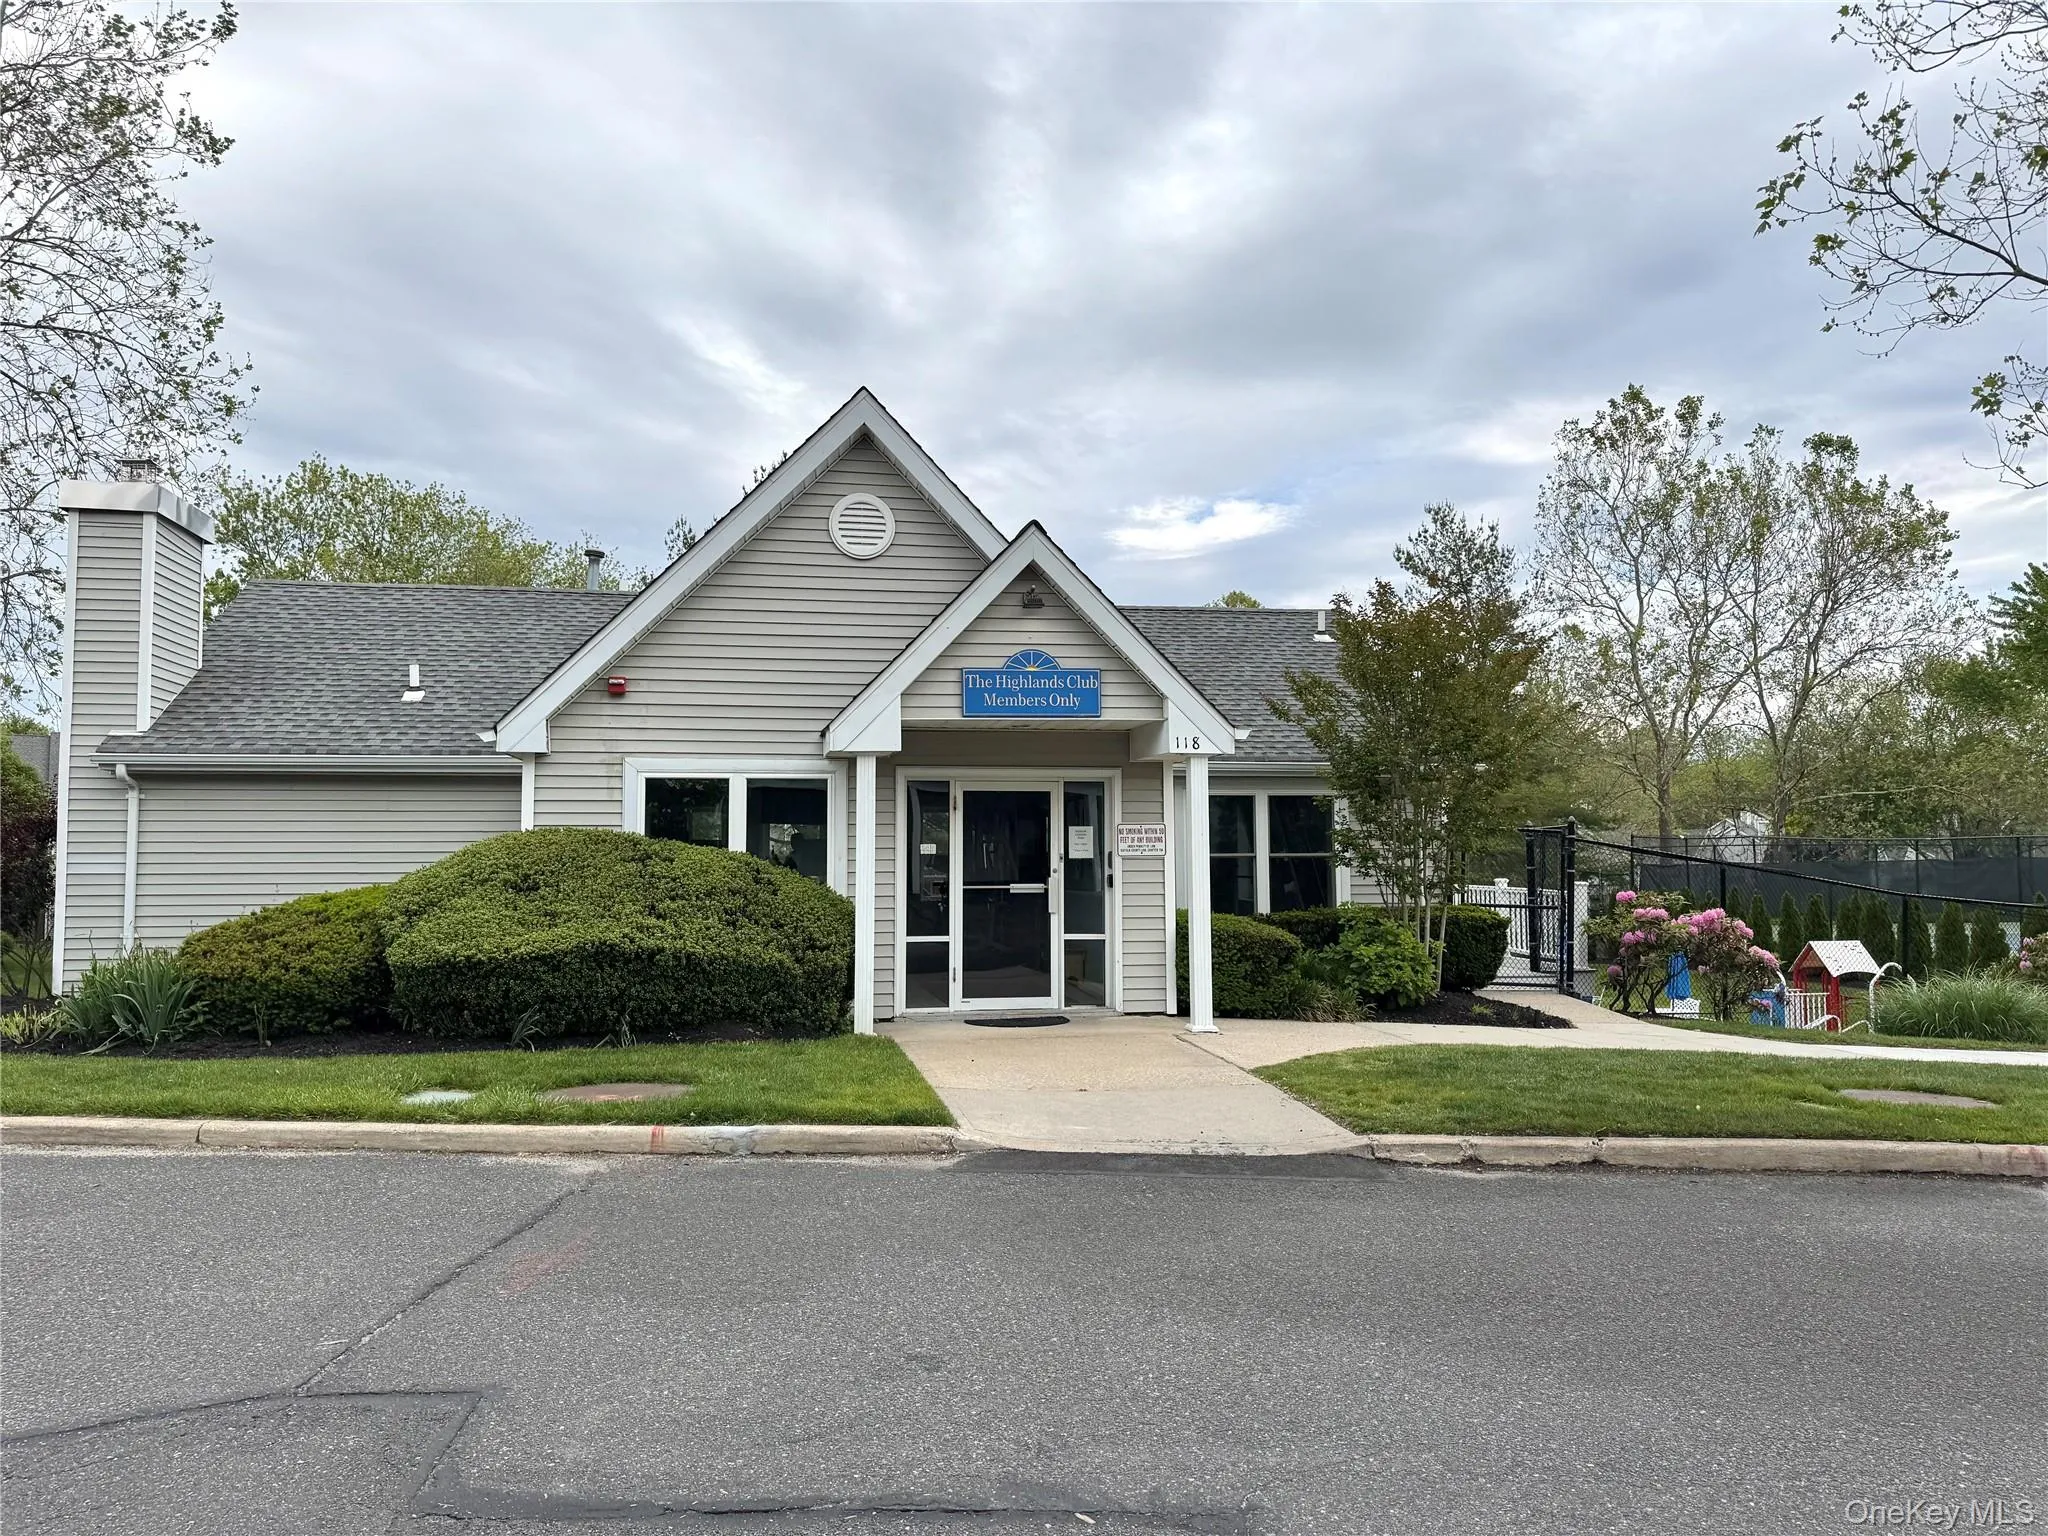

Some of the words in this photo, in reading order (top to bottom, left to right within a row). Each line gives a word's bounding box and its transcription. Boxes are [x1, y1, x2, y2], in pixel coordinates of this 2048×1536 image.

[966, 674, 993, 689] The
[996, 674, 1065, 692] Highlands
[1067, 674, 1098, 689] Club
[984, 693, 1047, 707] Members
[1049, 693, 1081, 710] Only
[1176, 736, 1200, 750] 118
